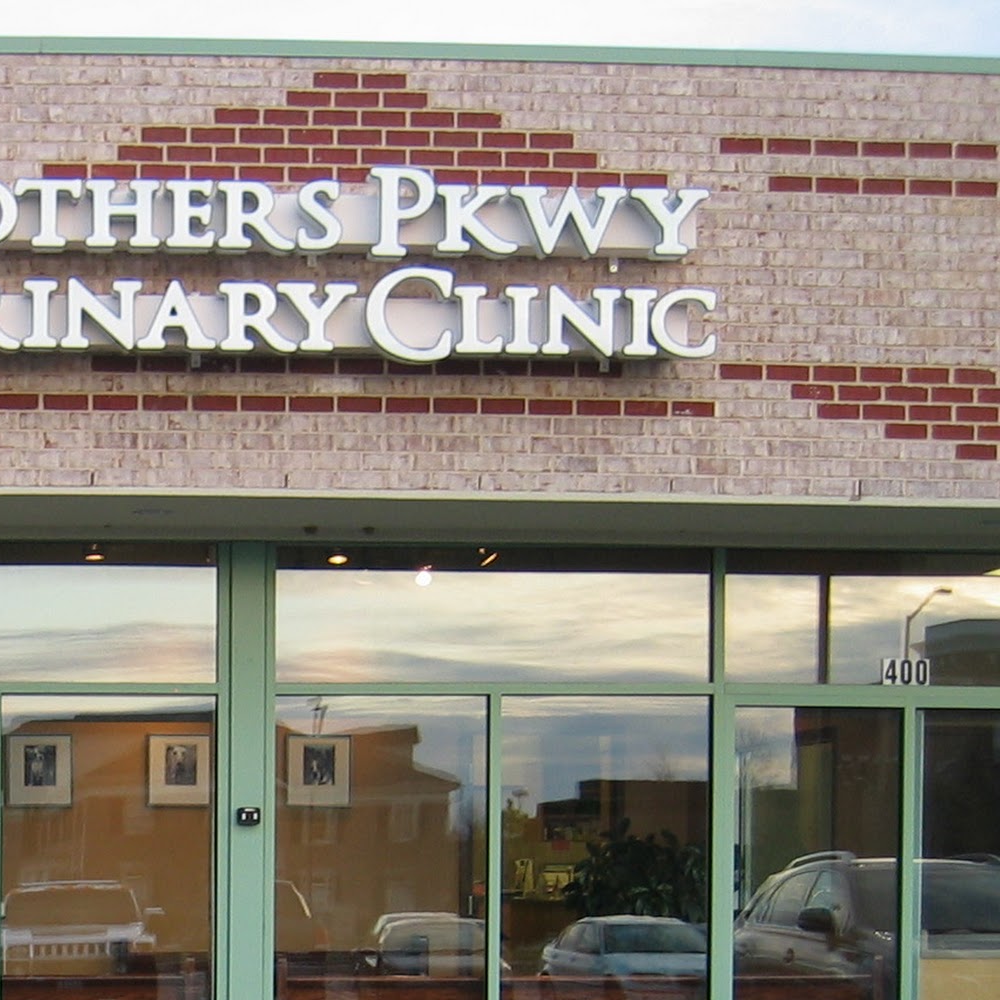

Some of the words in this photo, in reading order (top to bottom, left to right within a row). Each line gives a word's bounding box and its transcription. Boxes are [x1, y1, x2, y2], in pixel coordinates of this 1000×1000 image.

[369, 164, 710, 259] PKWY
[364, 265, 718, 362] CLINIC
[885, 659, 927, 685] 400
